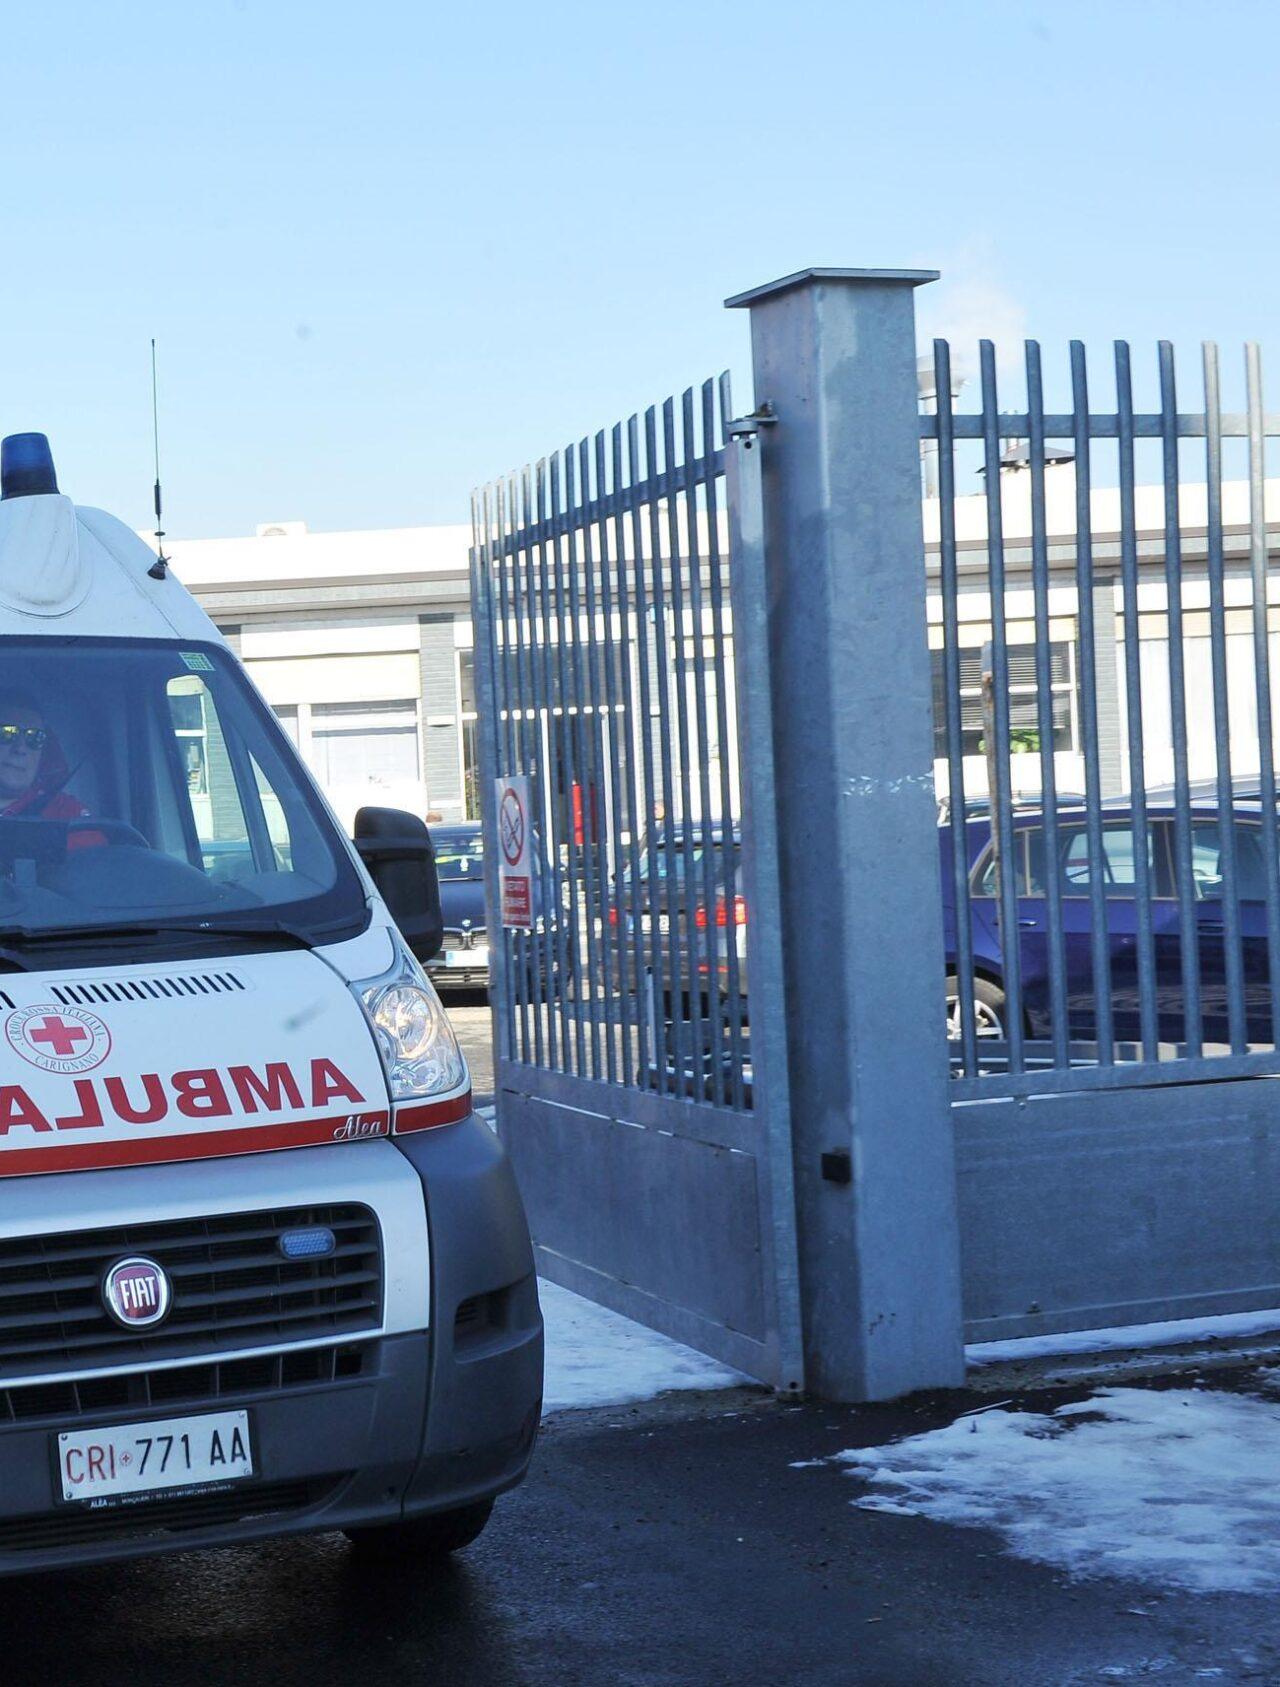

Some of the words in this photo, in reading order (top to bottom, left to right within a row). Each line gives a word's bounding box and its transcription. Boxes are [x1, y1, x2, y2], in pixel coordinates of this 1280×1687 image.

[34, 1053, 100, 1072] CARIGNANO
[119, 1276, 156, 1310] FIAT
[66, 1443, 117, 1484] CRI
[135, 1433, 192, 1476] 771
[209, 1426, 248, 1466] AA
